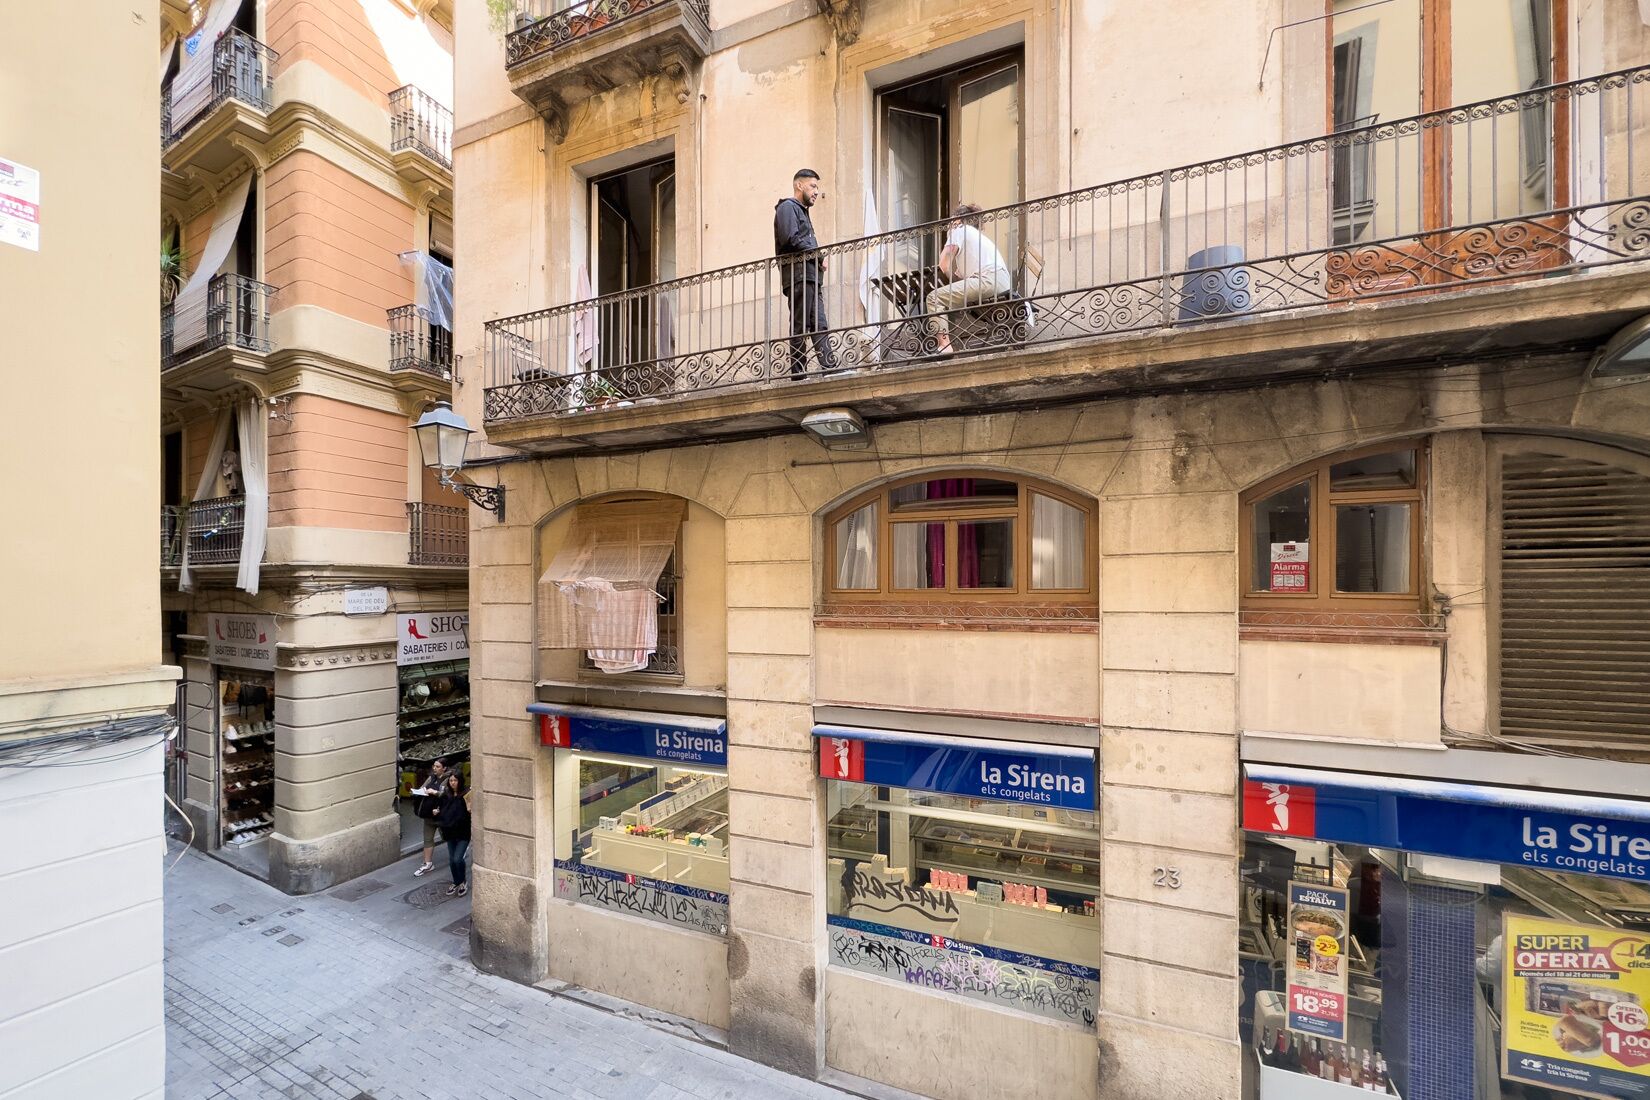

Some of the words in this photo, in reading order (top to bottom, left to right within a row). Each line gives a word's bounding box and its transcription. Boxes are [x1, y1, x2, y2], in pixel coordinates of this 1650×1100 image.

[1273, 563, 1306, 571] Alarma
[227, 620, 257, 640] SHOES
[431, 615, 468, 634] SHO
[215, 645, 237, 656] SABATERIES
[240, 647, 270, 660] COMPLEMENTS
[403, 642, 448, 655] SABATERIES
[655, 728, 670, 748] la
[672, 730, 724, 754] Sirena
[656, 747, 667, 757] els
[668, 750, 702, 761] congelats
[981, 760, 1002, 785] la
[1007, 764, 1086, 794] Sirena
[981, 784, 997, 795] els
[1000, 788, 1051, 802] congelats
[1522, 816, 1559, 849] la
[1568, 823, 1650, 860] Sire
[1522, 848, 1549, 864] els
[1555, 855, 1646, 876] congelats
[1152, 866, 1182, 890] 23
[1298, 894, 1337, 907] ESTALVI
[1306, 890, 1329, 899] PACK
[1520, 935, 1584, 951] SUPER
[1516, 952, 1611, 970] OFERTA
[1591, 972, 1611, 980] maig
[1293, 993, 1339, 1013] 18,99
[1615, 1004, 1643, 1014] OFERTA
[1546, 1063, 1561, 1072] Tria
[1566, 1072, 1588, 1082] Sirena
